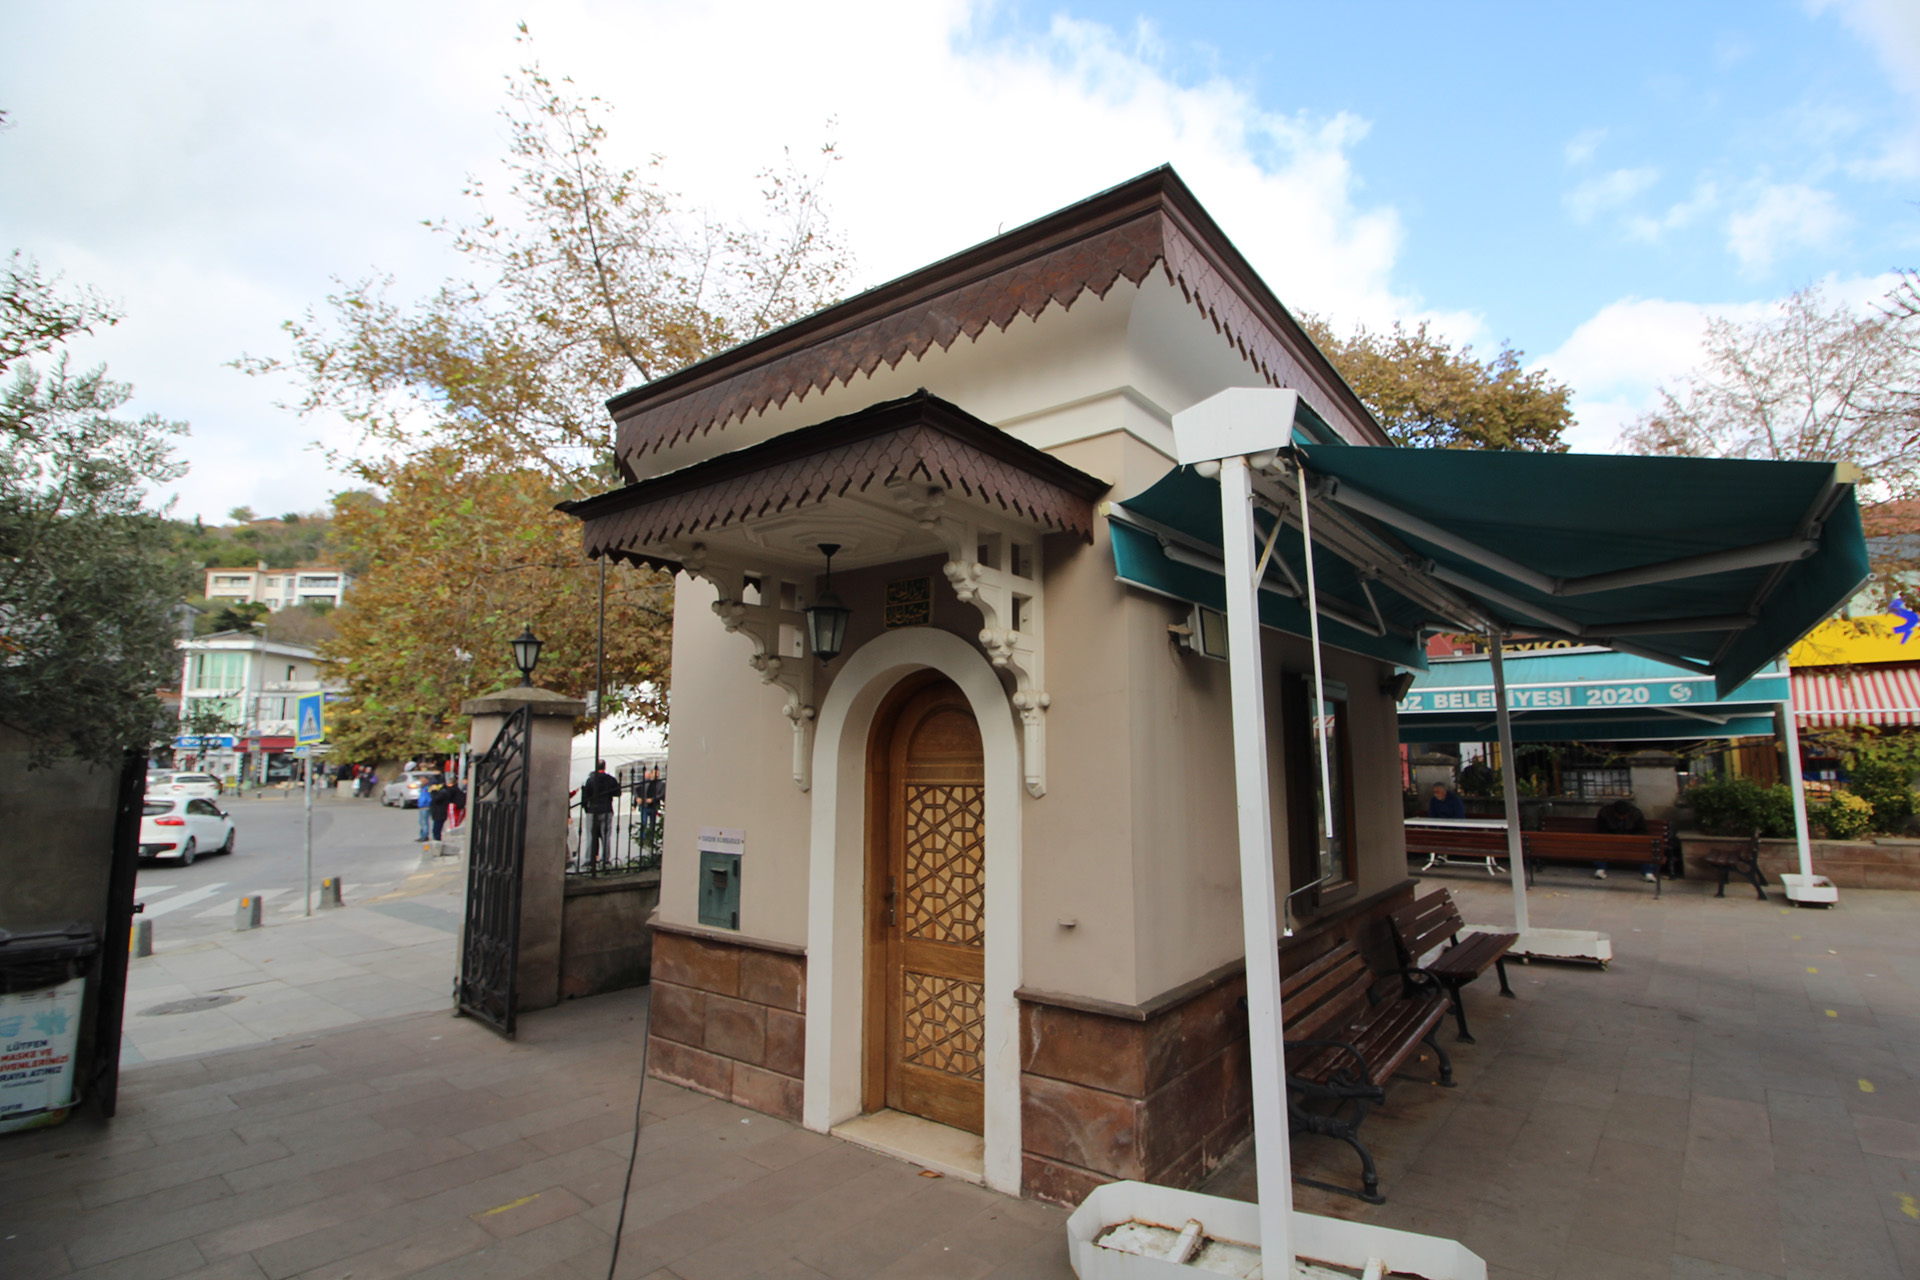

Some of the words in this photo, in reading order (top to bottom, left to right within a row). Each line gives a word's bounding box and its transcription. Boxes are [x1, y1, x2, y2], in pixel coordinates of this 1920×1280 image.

[1483, 639, 1585, 656] EYKO
[1434, 688, 1571, 709] BELEİYESİ
[1586, 687, 1650, 705] 2020
[1, 1051, 37, 1061] MASKE
[40, 1048, 53, 1057] VE
